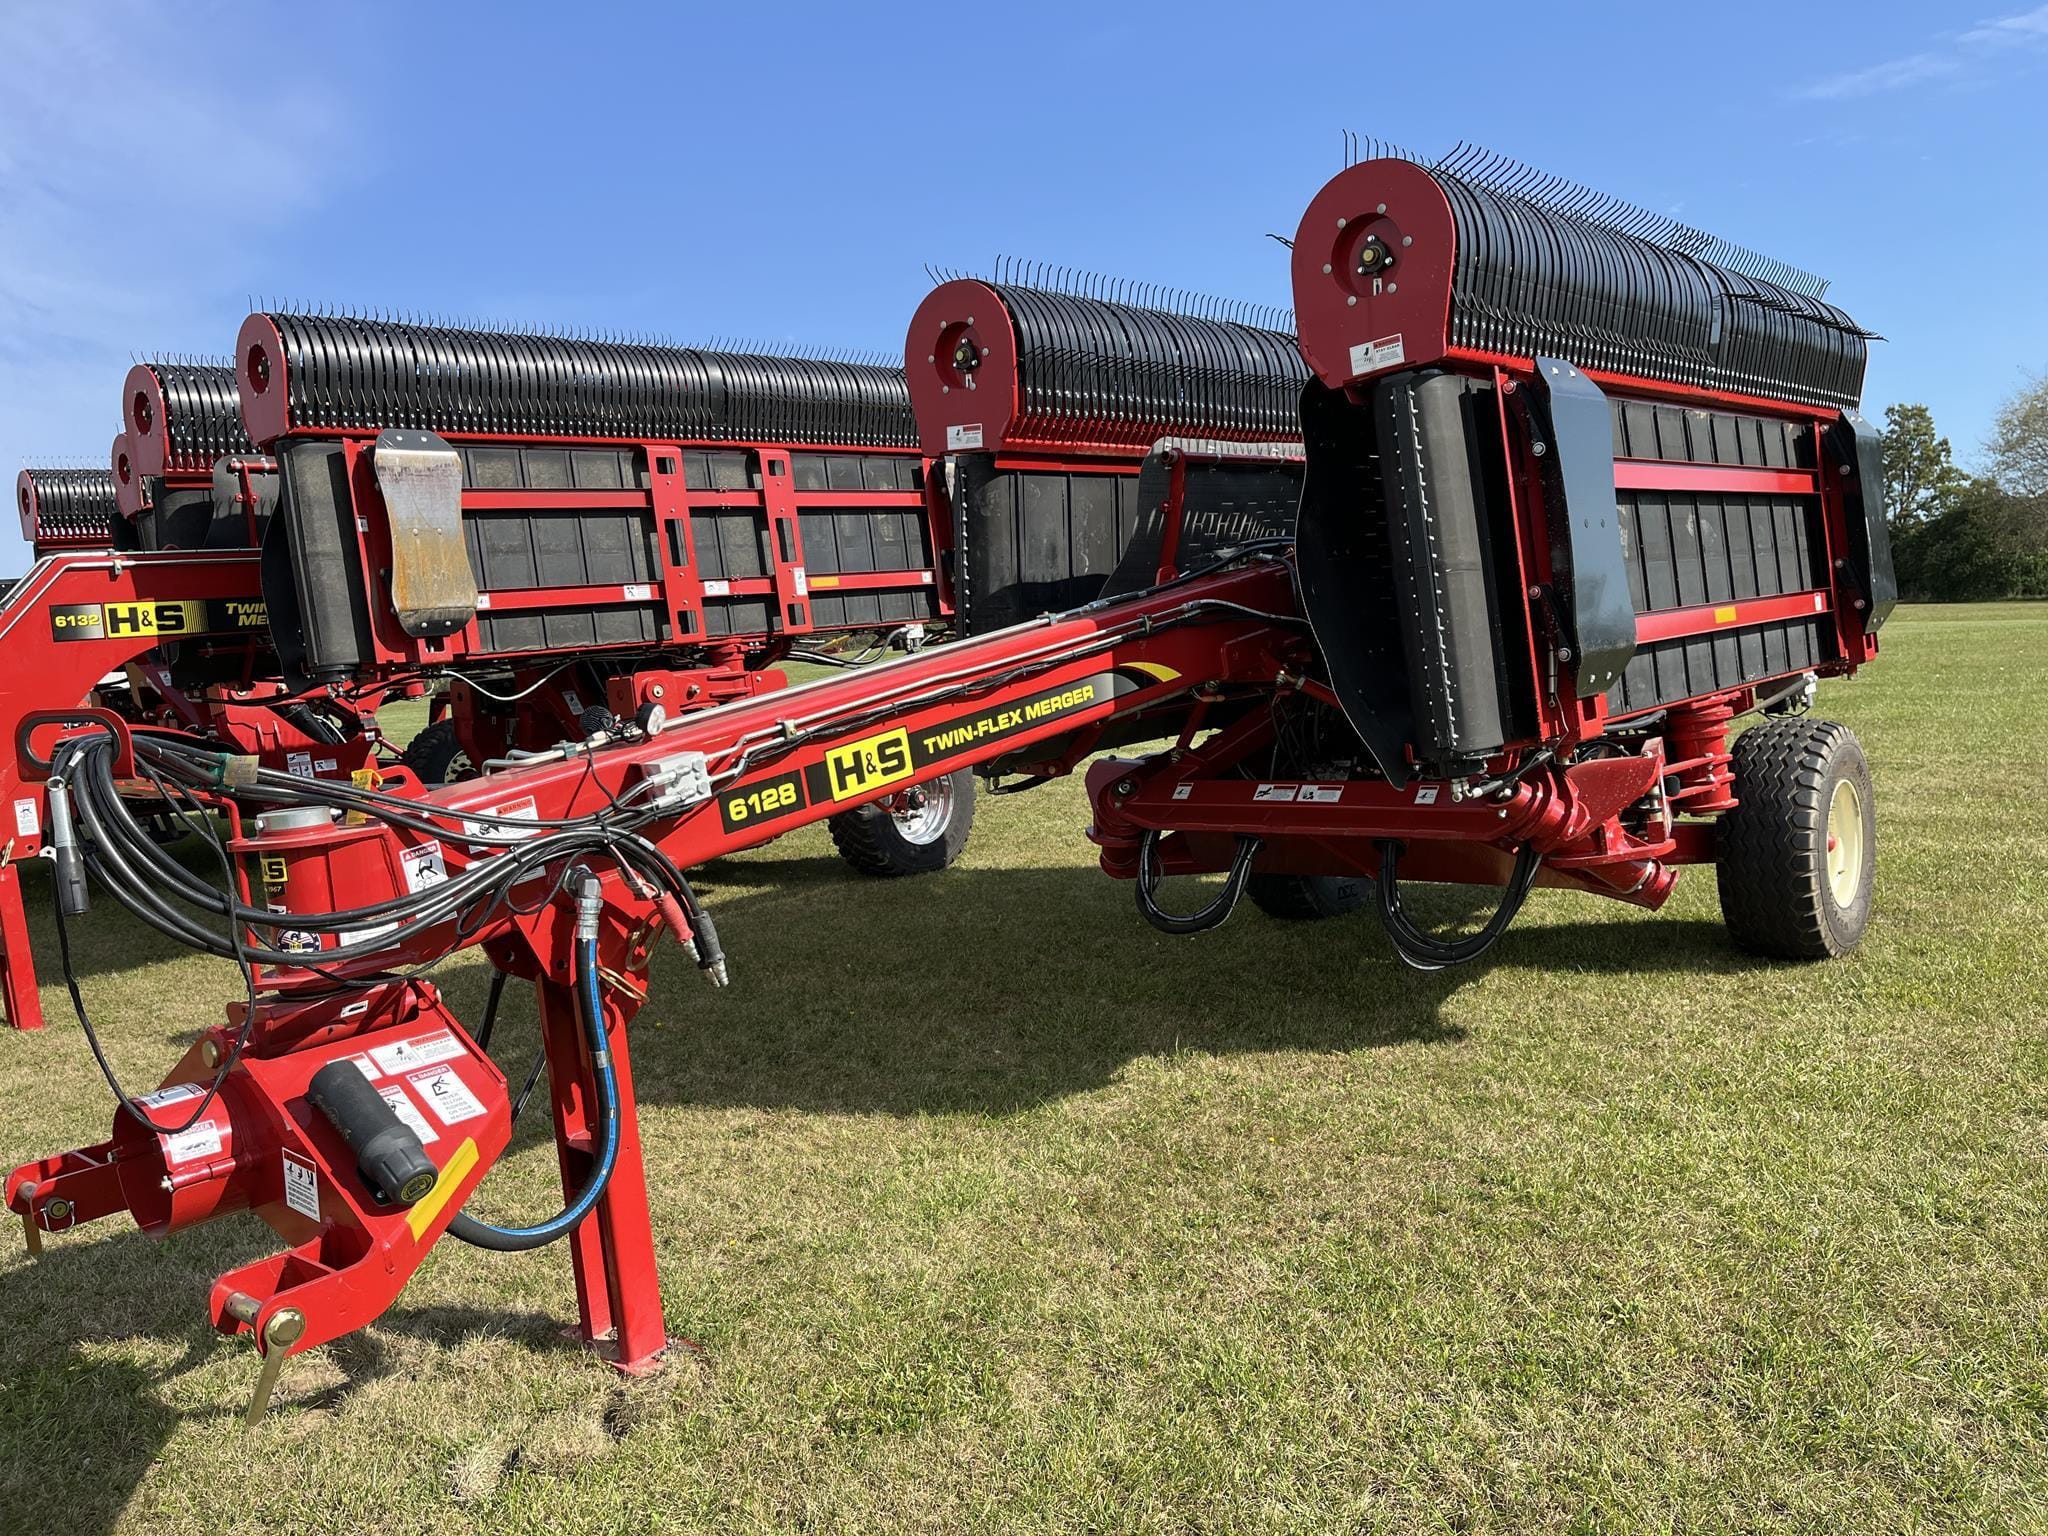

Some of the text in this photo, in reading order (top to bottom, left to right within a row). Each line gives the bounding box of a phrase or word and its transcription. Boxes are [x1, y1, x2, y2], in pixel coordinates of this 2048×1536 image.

[55, 604, 185, 634] 6132 H&S
[728, 684, 1095, 822] 6128 H&S TWIN-FLEX MERGER
[411, 844, 437, 858] DANGER
[420, 1066, 449, 1078] DANGER
